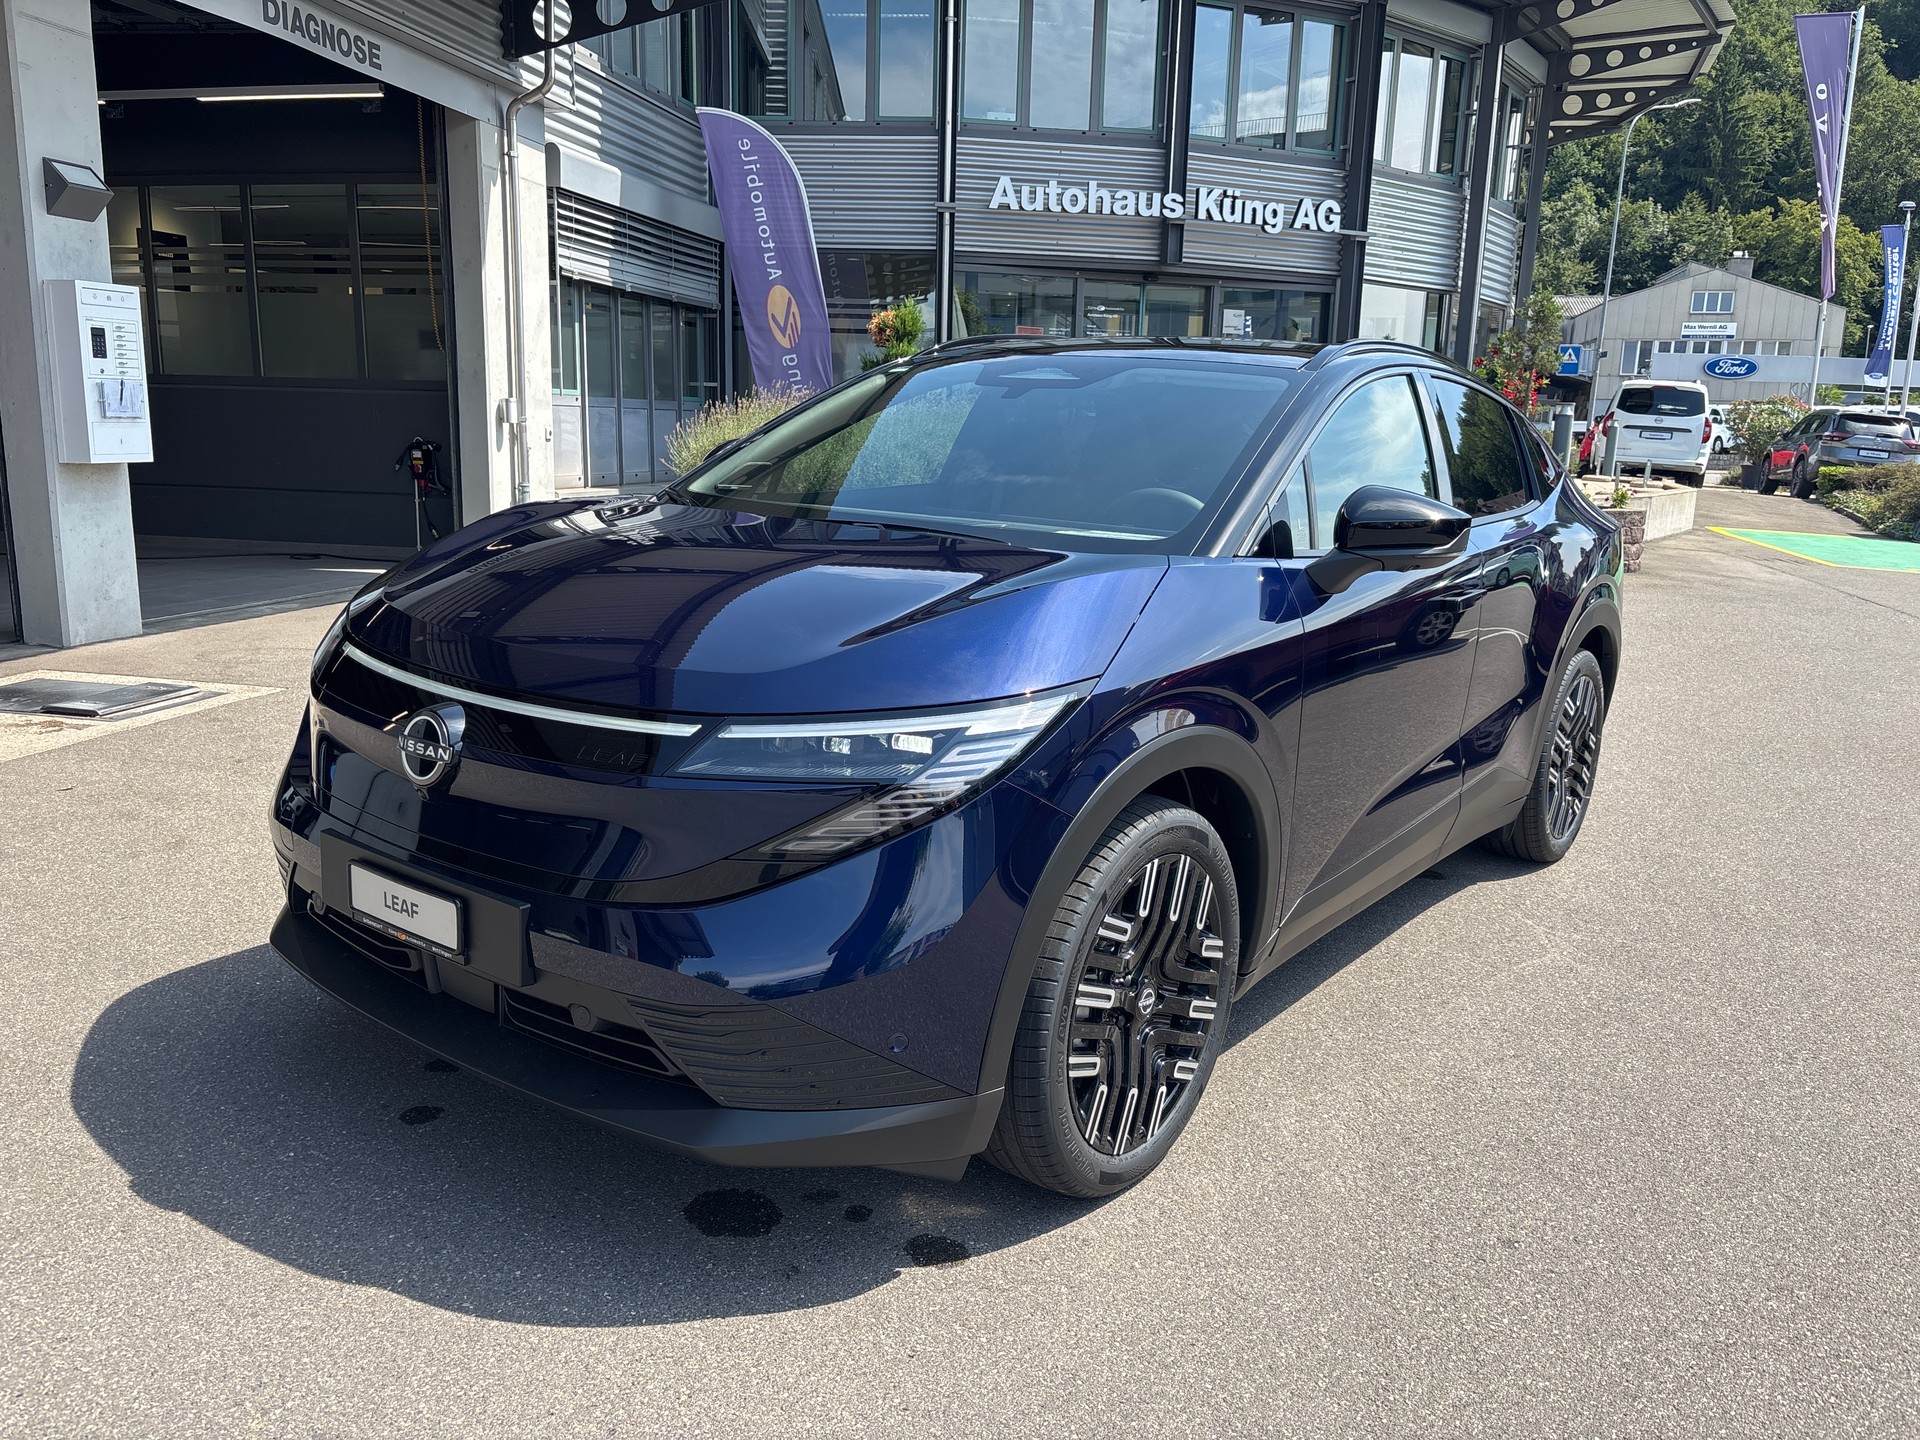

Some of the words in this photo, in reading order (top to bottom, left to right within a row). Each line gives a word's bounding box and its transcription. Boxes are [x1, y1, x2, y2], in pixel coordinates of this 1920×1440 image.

[262, 0, 383, 71] DIAGNOSE
[988, 175, 1185, 219] Autohaus
[1196, 187, 1284, 234] Küng
[1292, 197, 1342, 233] AG
[1714, 359, 1749, 374] Ford
[398, 735, 451, 761] NISSAN
[383, 890, 419, 919] LEAF
